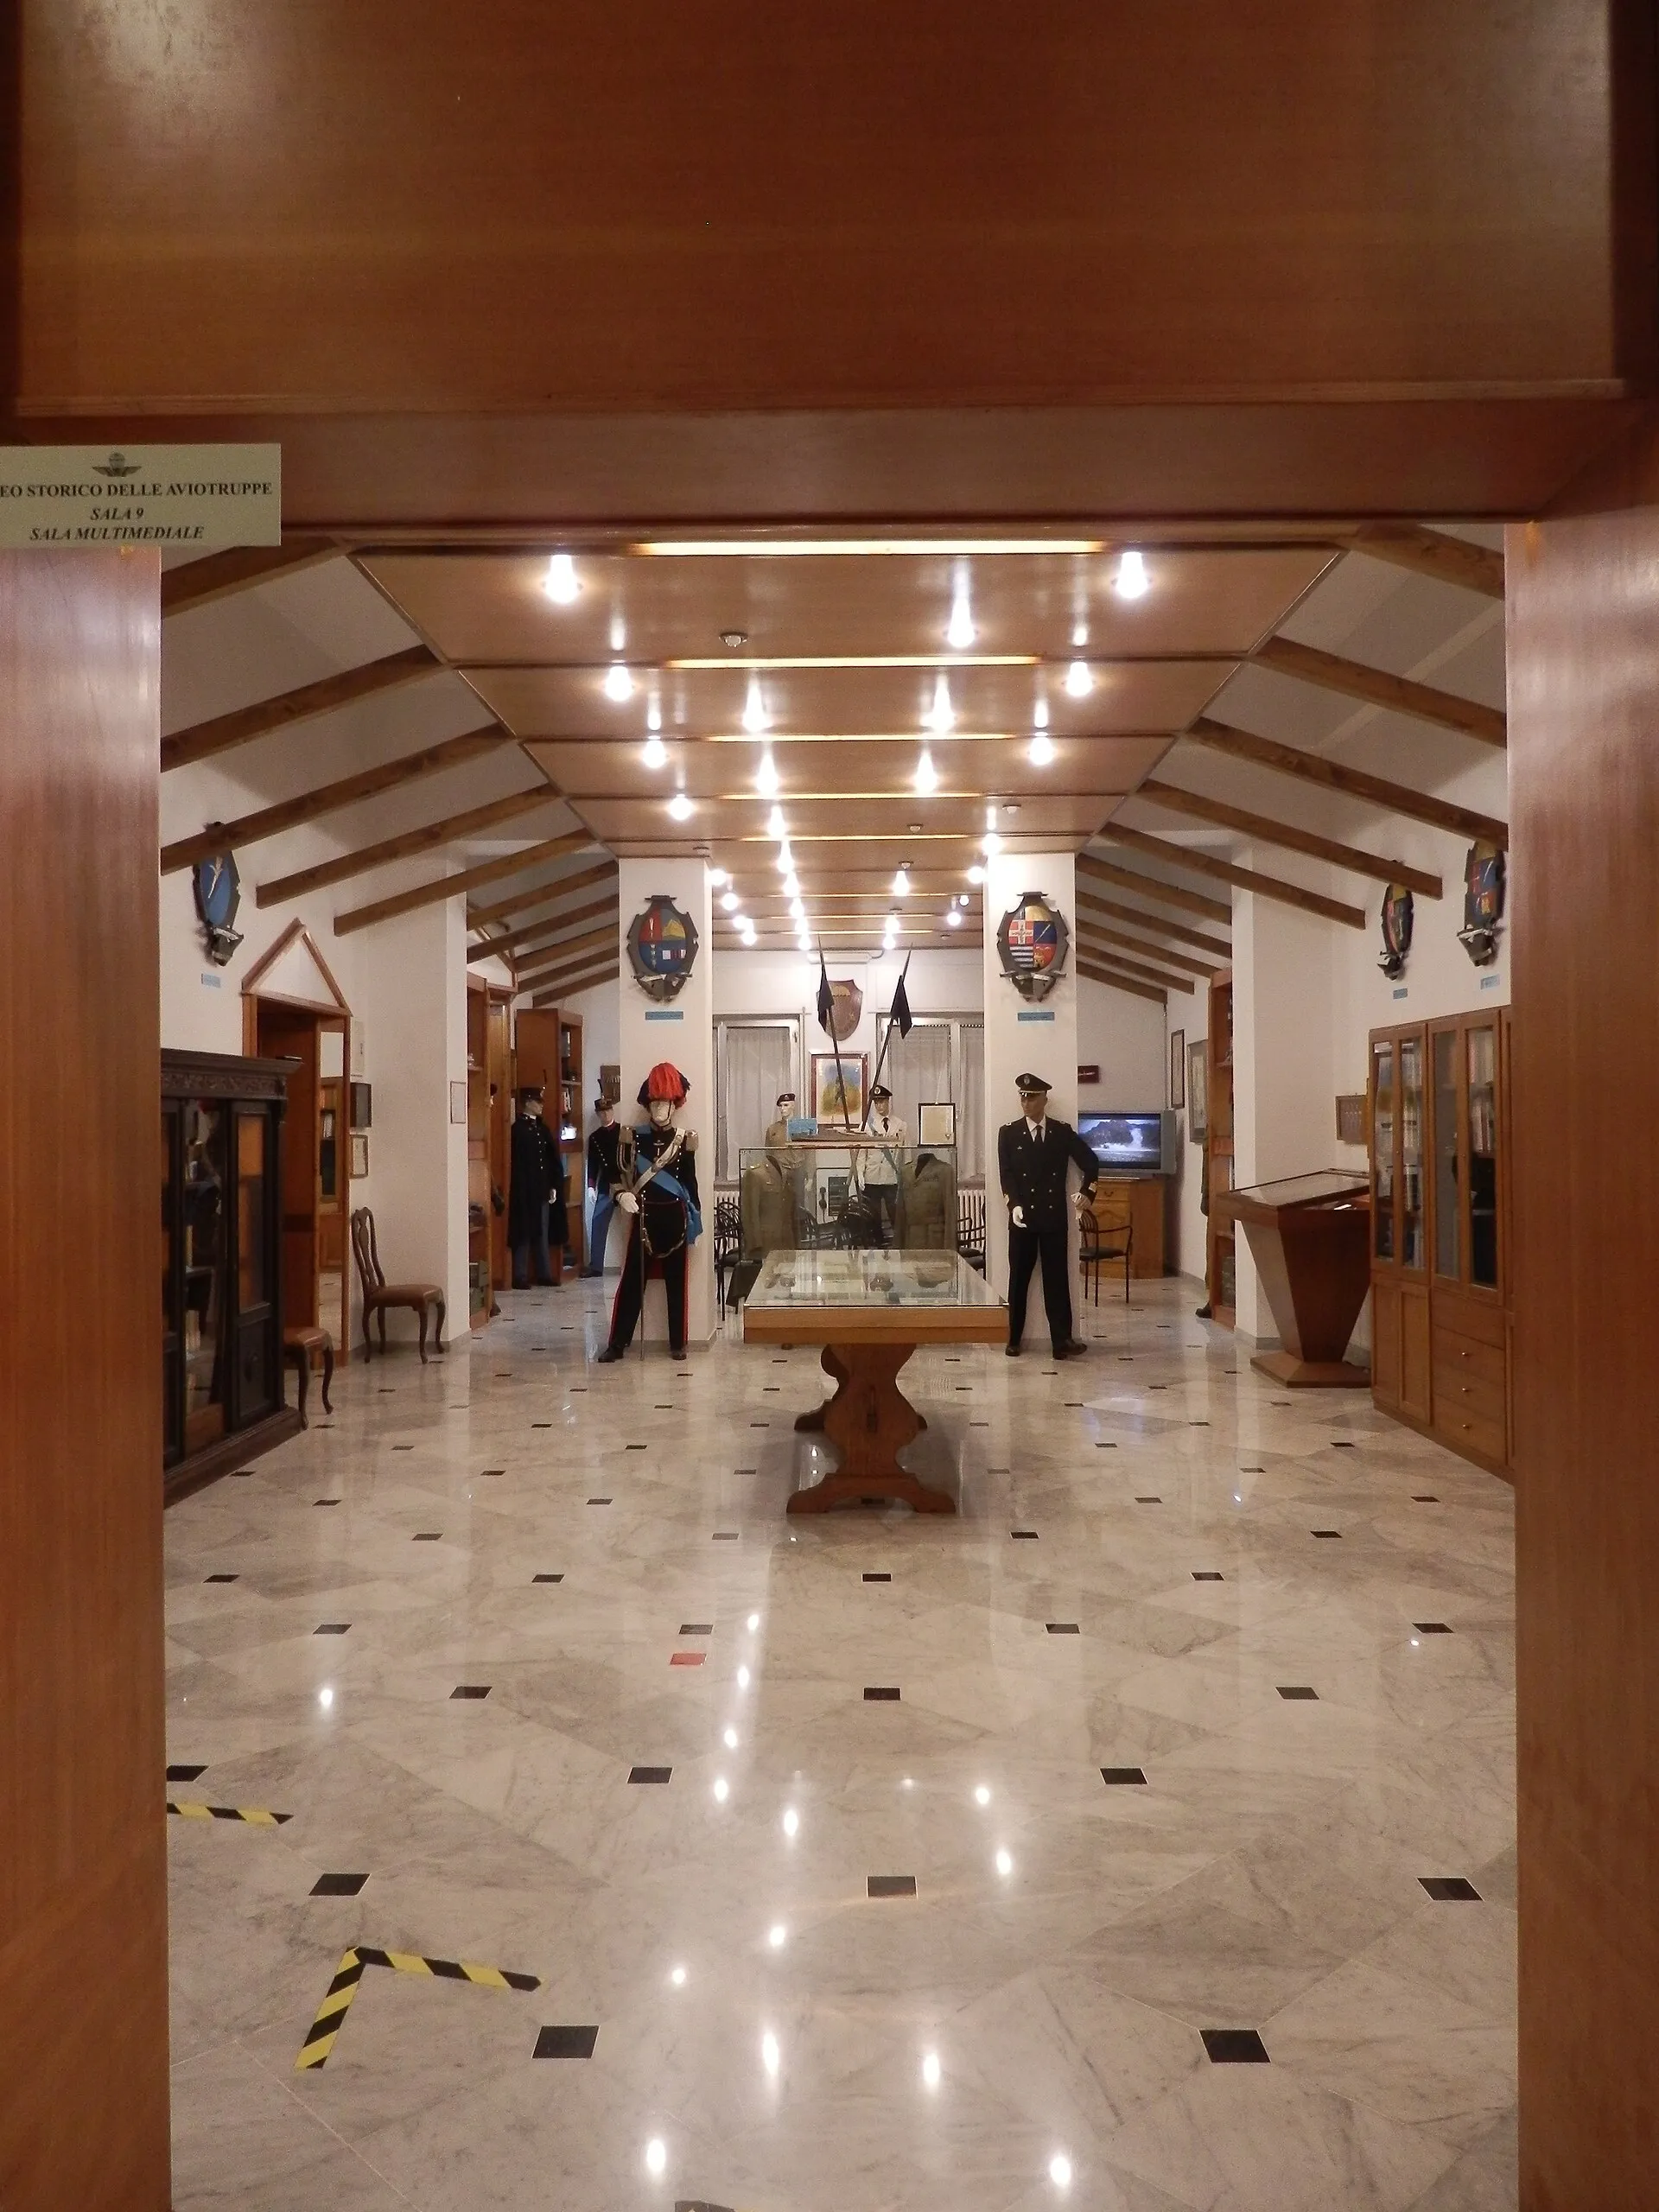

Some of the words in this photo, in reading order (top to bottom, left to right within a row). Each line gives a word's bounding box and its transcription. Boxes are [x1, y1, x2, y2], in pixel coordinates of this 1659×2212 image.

[27, 483, 103, 498] STORICO
[107, 483, 162, 497] DELLE
[166, 482, 273, 496] AVIOTRUPPE
[90, 508, 130, 521] SALA
[136, 507, 144, 519] 9
[29, 527, 71, 541] SALA
[74, 526, 205, 540] MULTIMEDIALE
